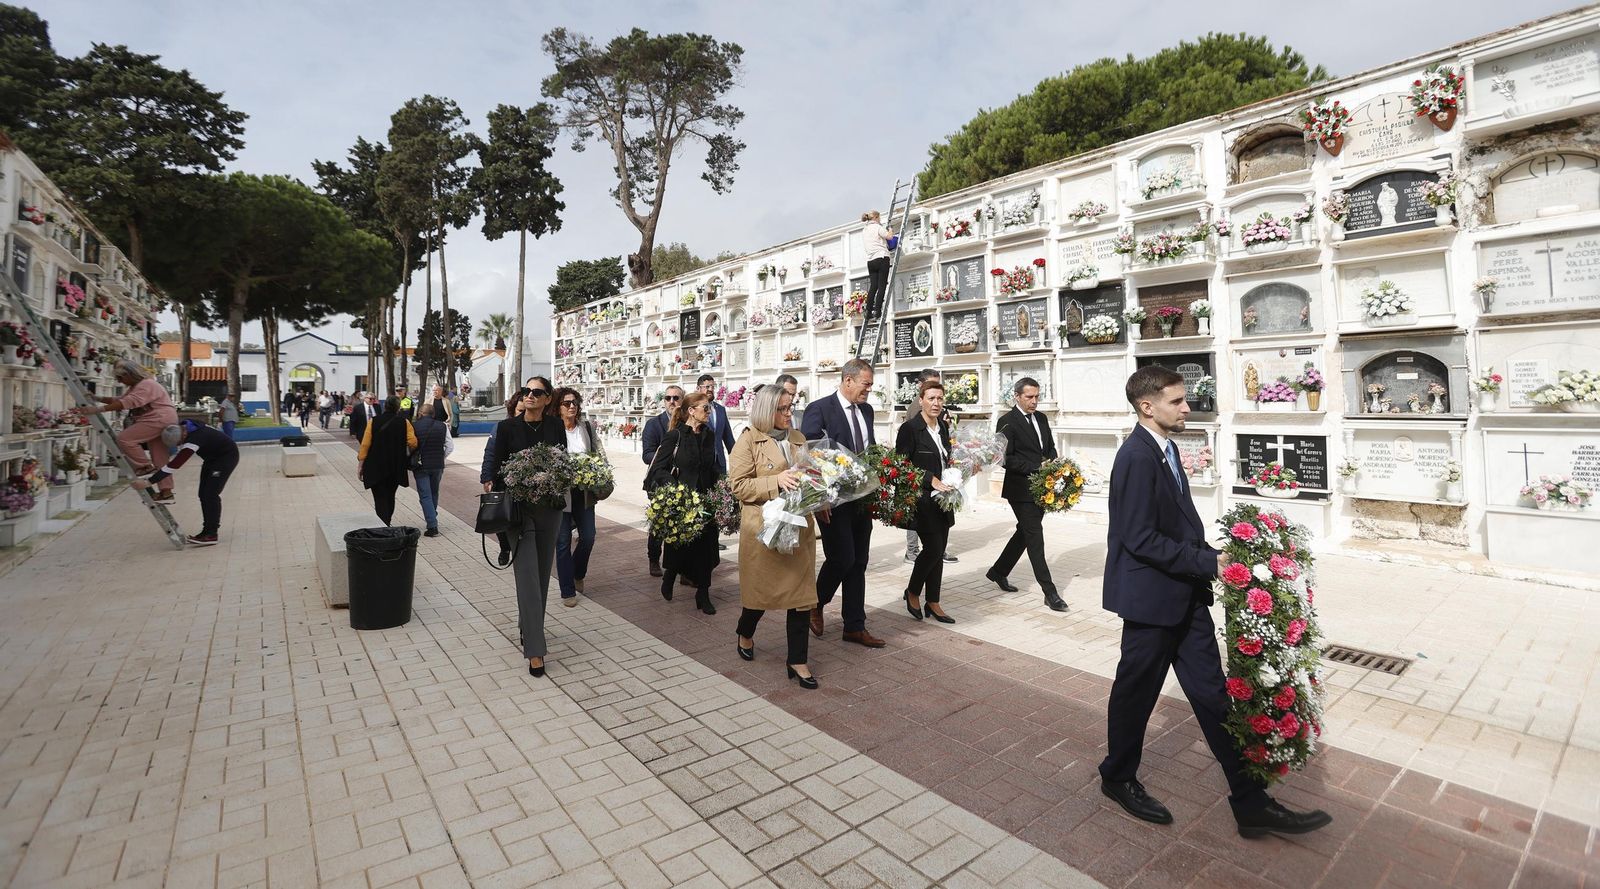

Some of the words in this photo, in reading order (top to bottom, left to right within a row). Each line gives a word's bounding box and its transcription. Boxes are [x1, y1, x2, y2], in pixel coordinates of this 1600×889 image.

[1576, 240, 1598, 249] ANA
[1496, 250, 1519, 258] JOSE
[1493, 257, 1522, 267] PEREZ
[1487, 266, 1530, 276] ESPINOSA
